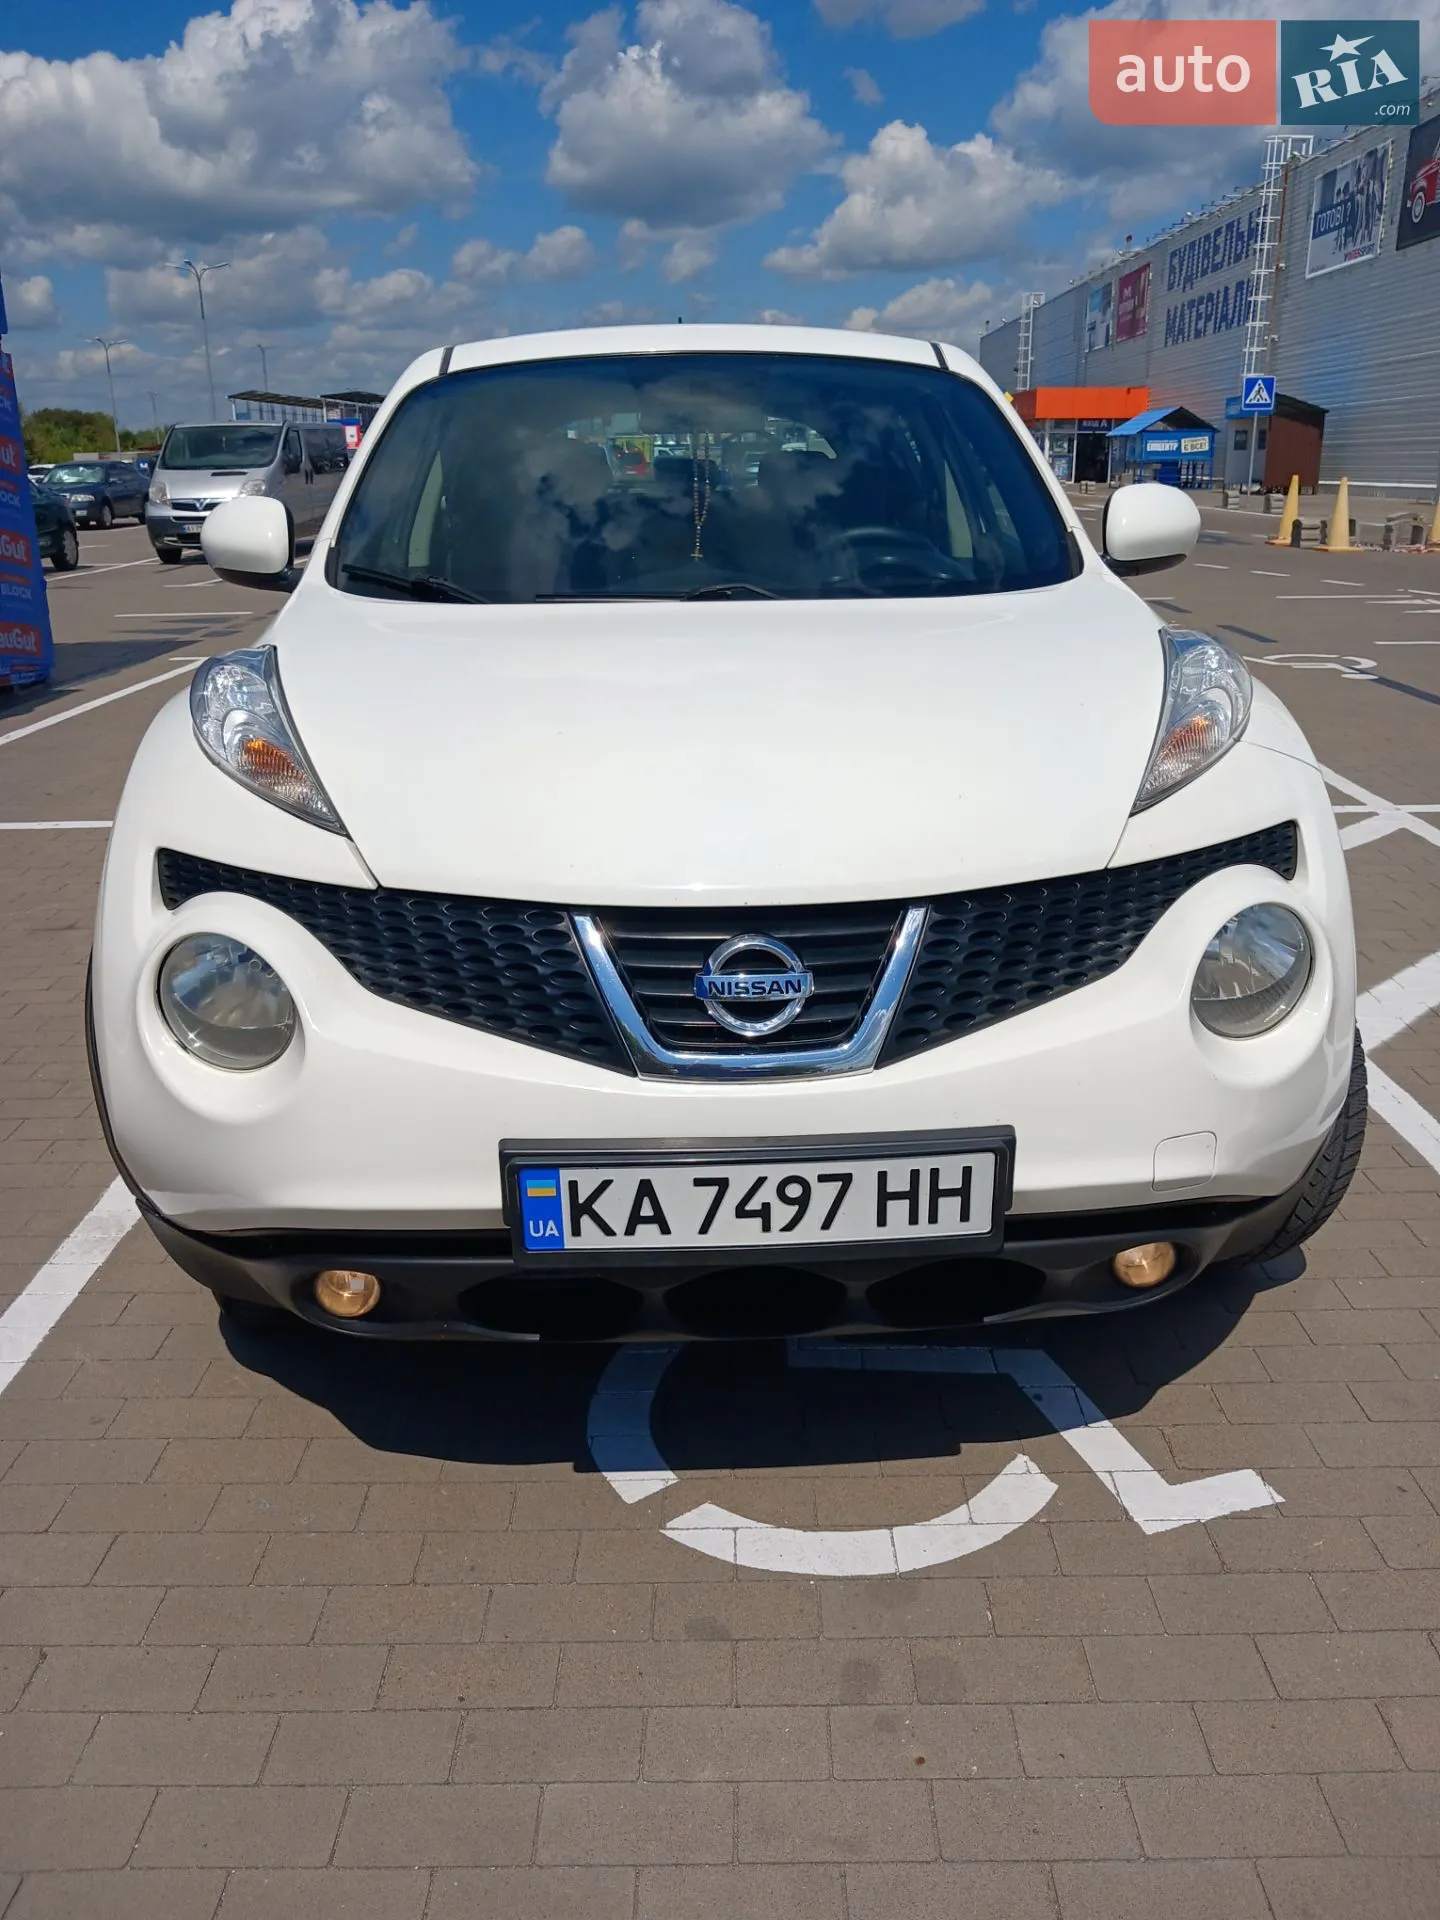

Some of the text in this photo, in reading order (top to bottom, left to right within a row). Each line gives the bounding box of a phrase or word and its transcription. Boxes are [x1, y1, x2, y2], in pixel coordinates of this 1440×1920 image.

[708, 979, 802, 996] NISSAN
[568, 1165, 973, 1237] KA 7497 HH
[529, 1220, 559, 1238] UA
